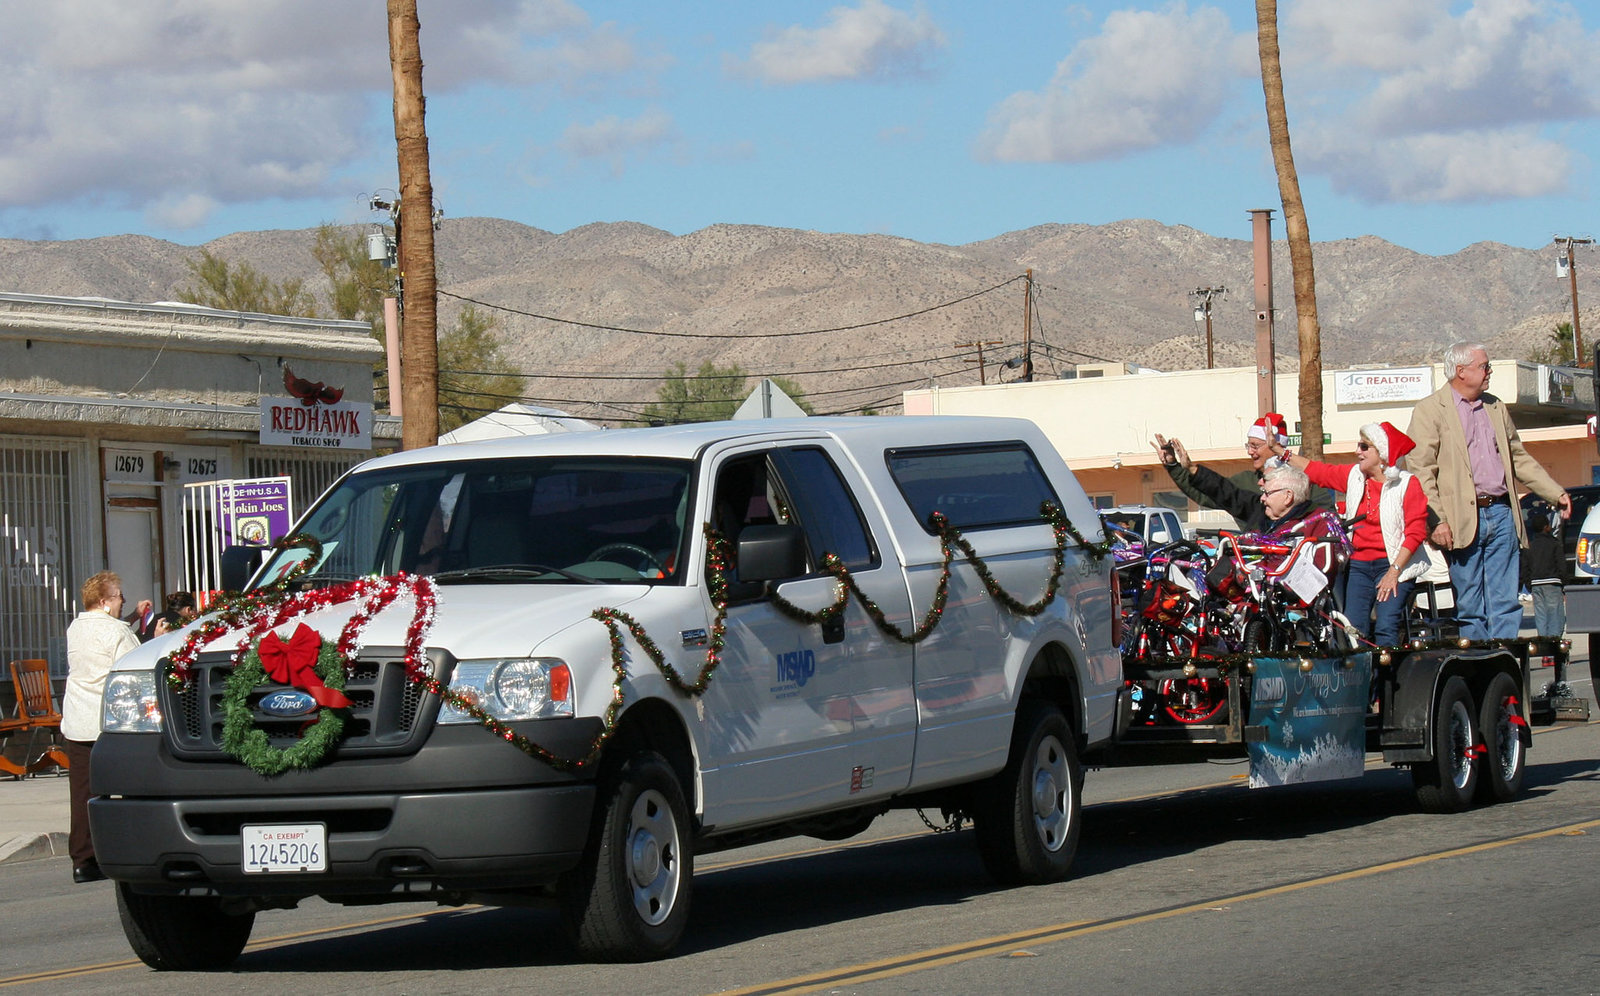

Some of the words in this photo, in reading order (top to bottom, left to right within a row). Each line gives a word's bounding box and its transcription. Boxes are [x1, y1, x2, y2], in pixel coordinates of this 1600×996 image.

[1347, 375, 1363, 386] JC
[1366, 376, 1421, 385] REALTORS
[271, 405, 361, 435] REDHAWK
[292, 437, 321, 447] TOBACCO
[115, 455, 144, 473] 12679
[188, 458, 217, 475] 12675
[257, 487, 282, 496] U.S.A.
[270, 695, 304, 709] Ford
[263, 833, 273, 841] CA
[277, 832, 305, 840] EXEMPT
[249, 843, 319, 865] 1245206
